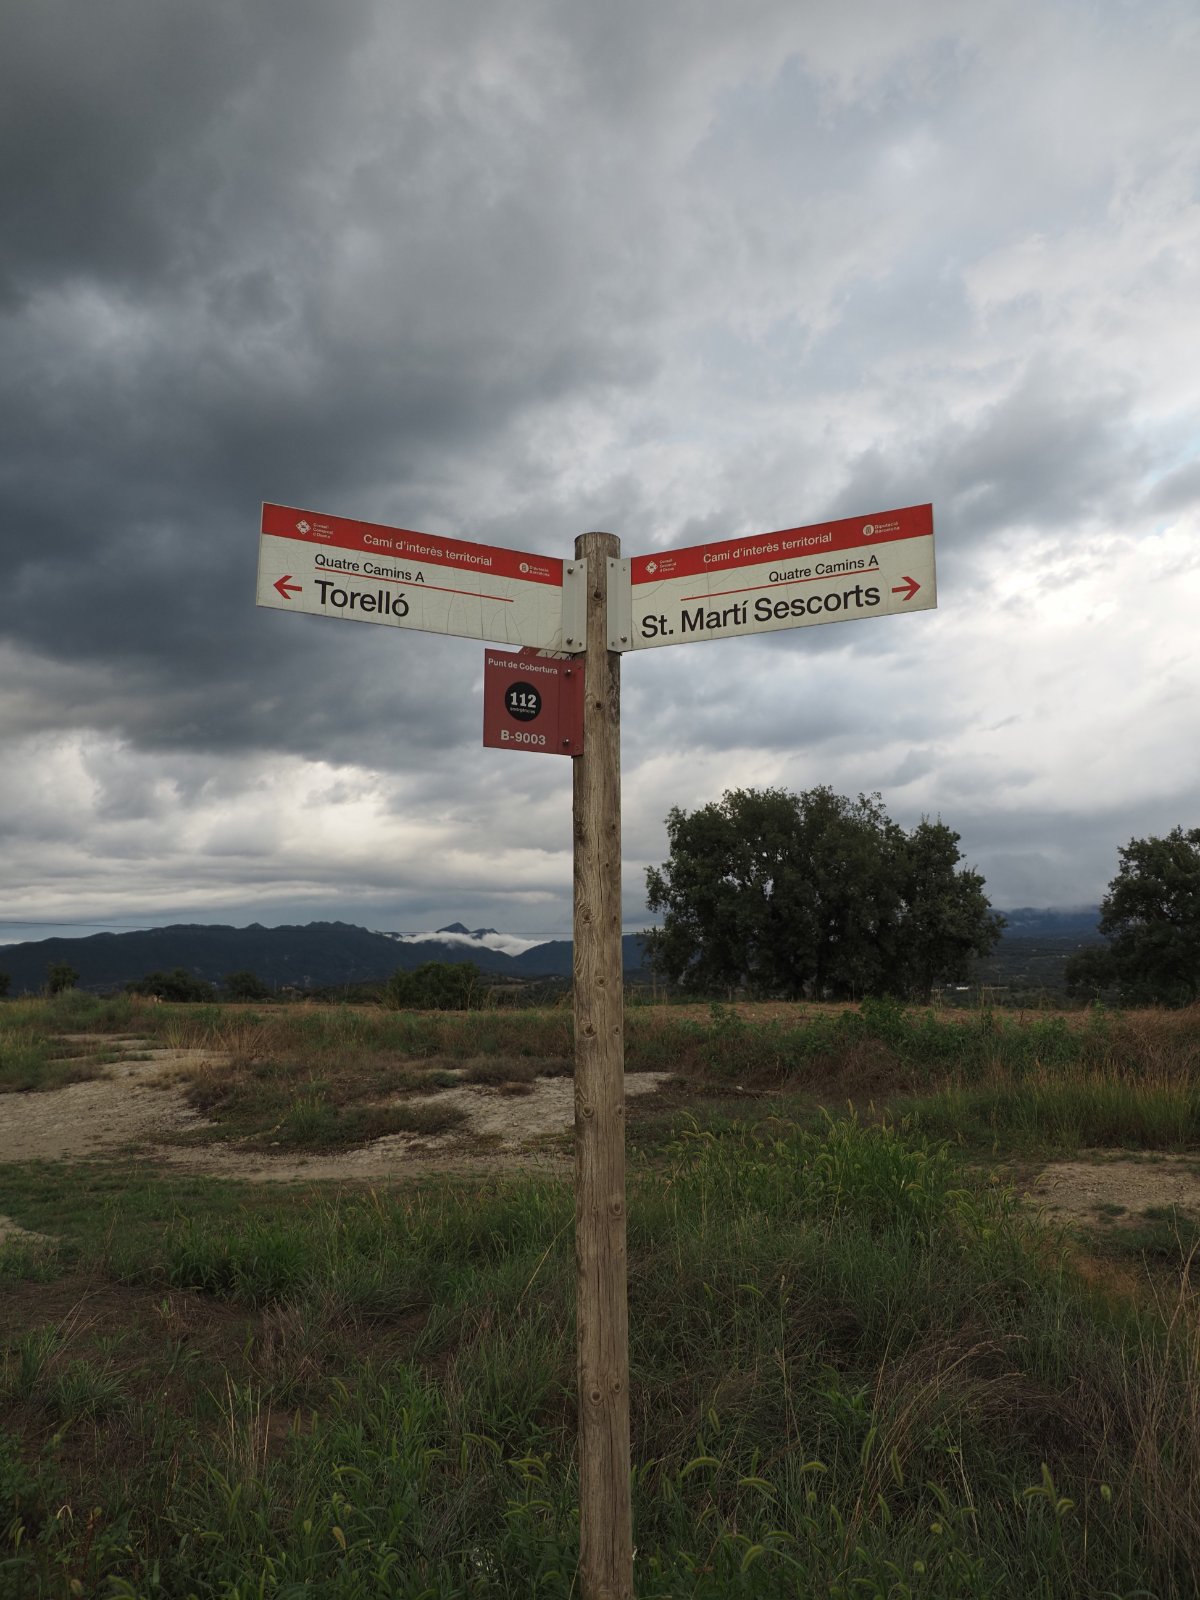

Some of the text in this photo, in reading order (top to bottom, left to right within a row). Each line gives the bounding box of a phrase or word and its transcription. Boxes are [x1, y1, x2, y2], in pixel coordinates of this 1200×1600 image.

[446, 549, 492, 566] territorial
[733, 543, 779, 558] d'interès
[782, 532, 832, 550] territorial
[314, 553, 425, 583] Quatre Camins A
[768, 554, 879, 582] Quatre Camins A
[314, 579, 409, 617] Torelló
[641, 584, 881, 638] St. Martí Sescorts
[488, 658, 558, 675] Punt de Cobertura
[510, 691, 537, 708] 112
[500, 729, 546, 745] B-9003
